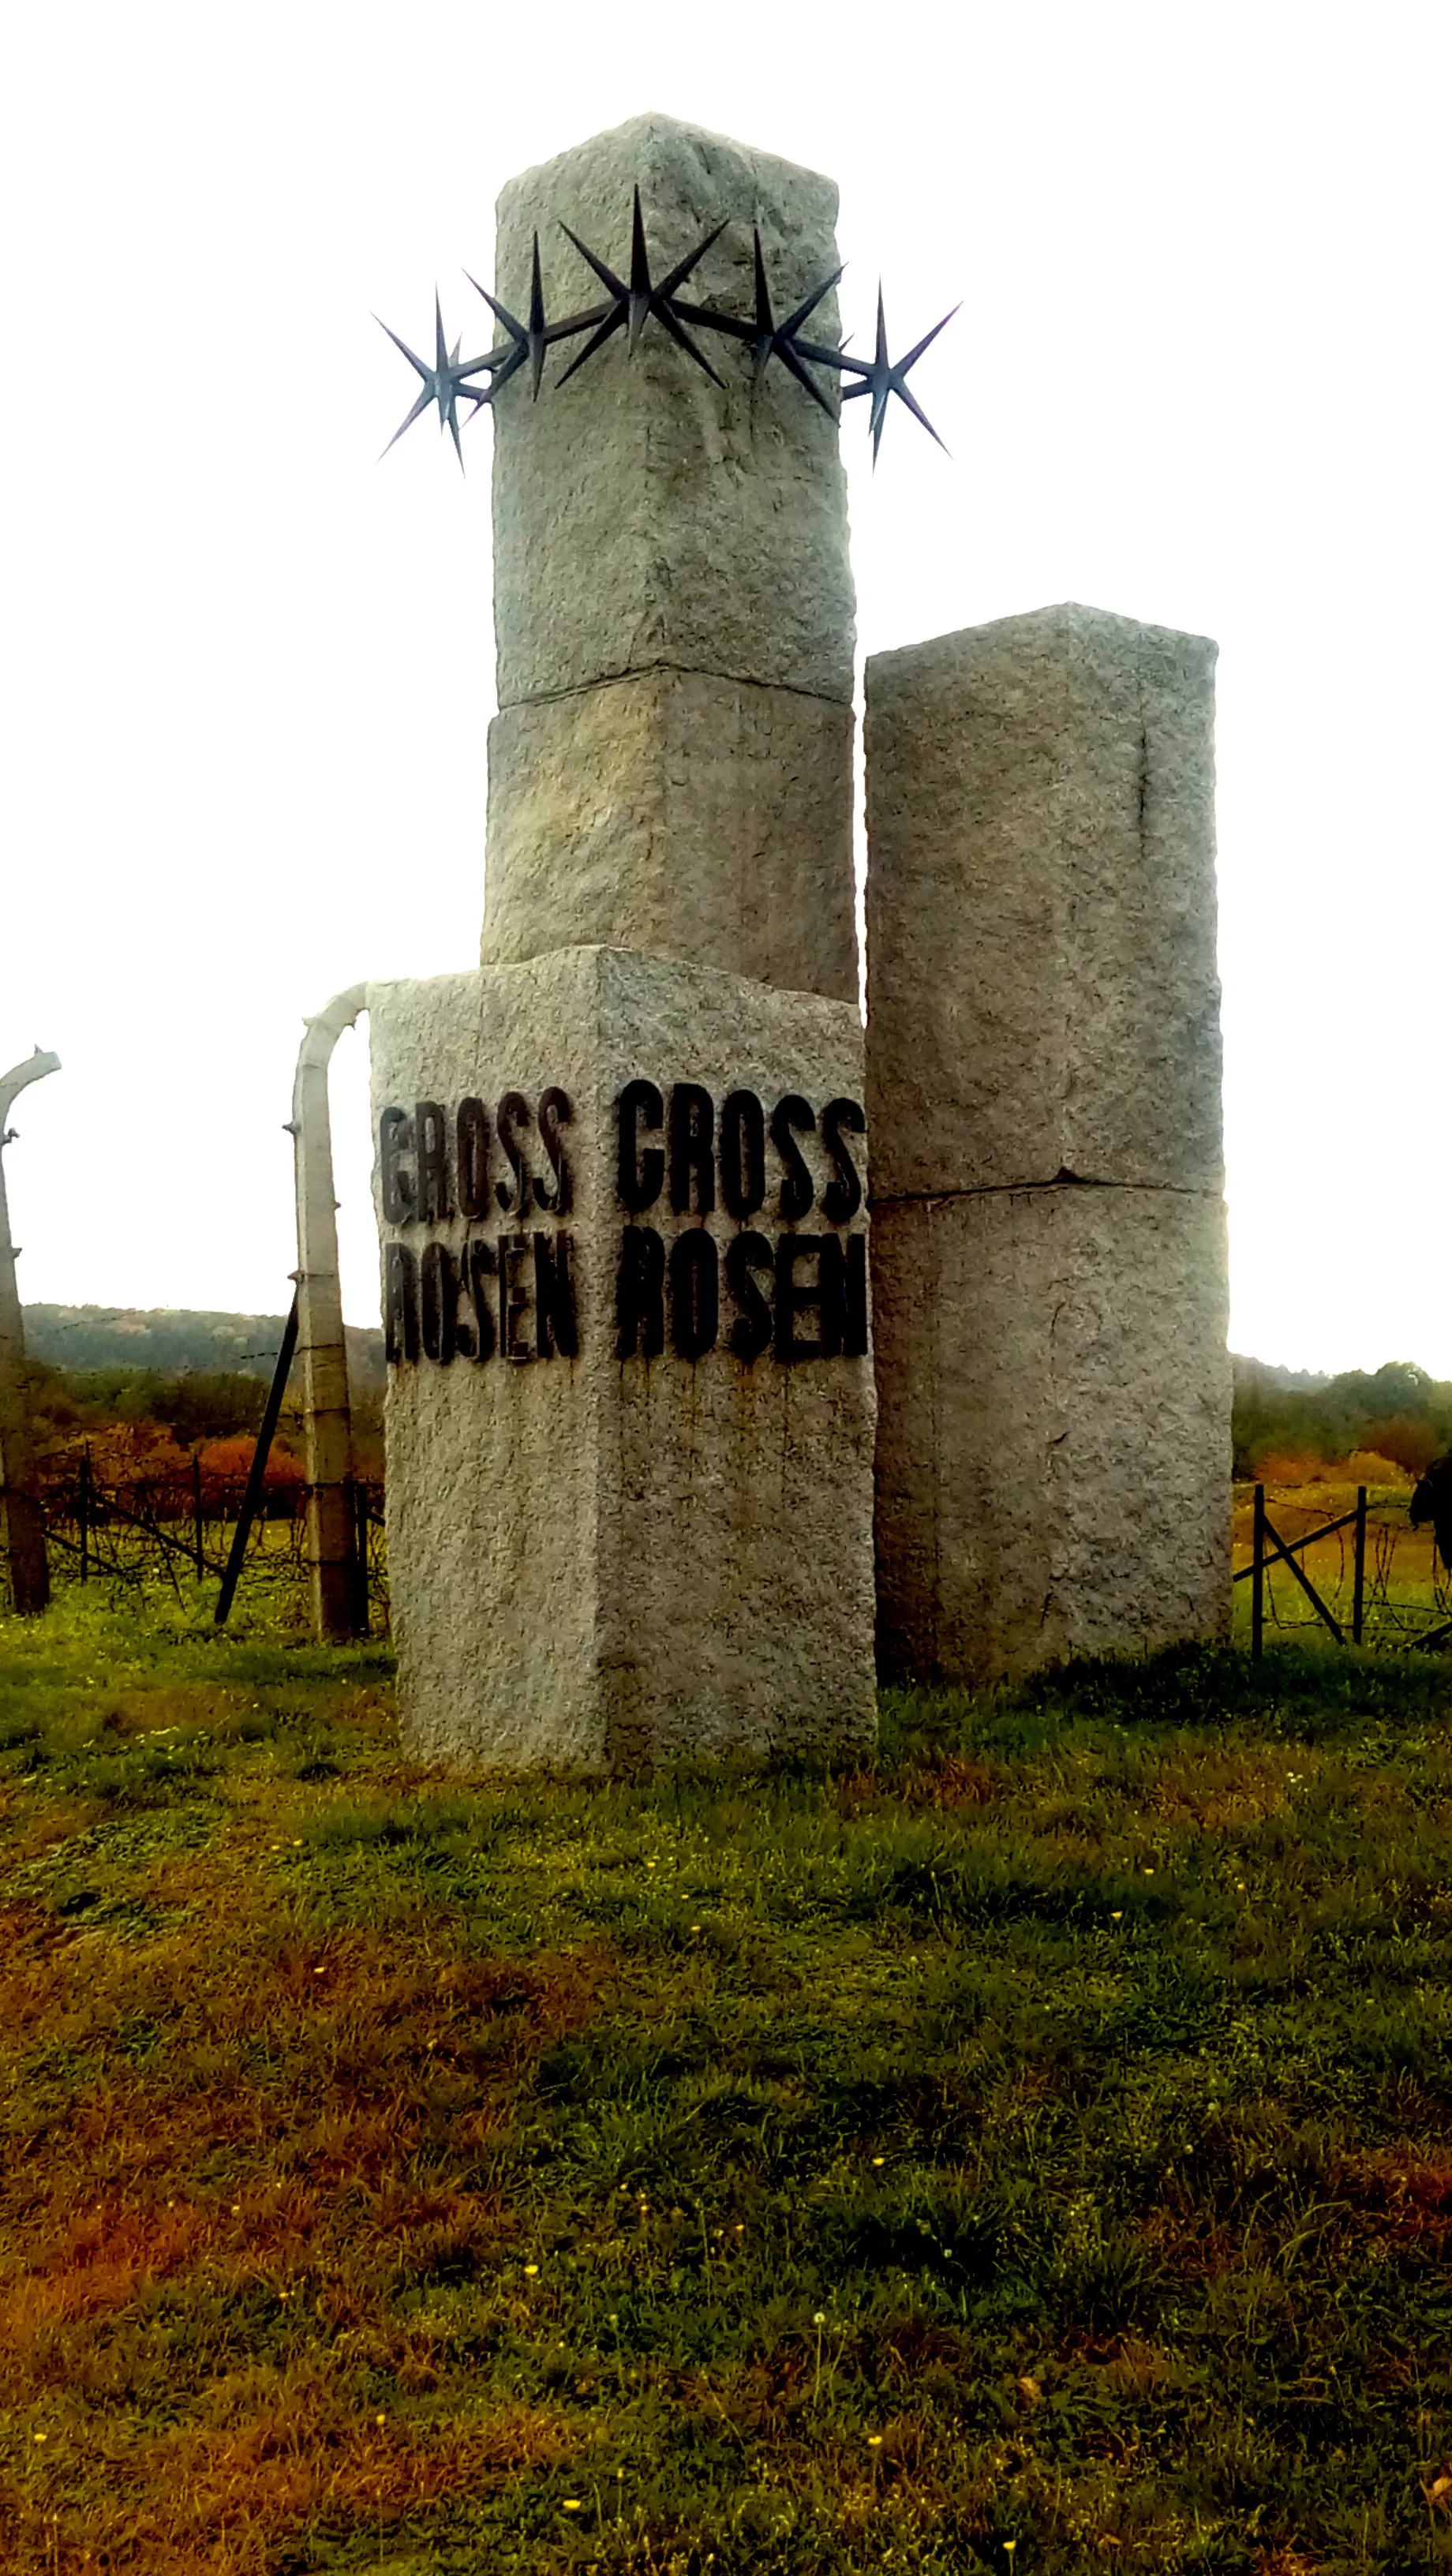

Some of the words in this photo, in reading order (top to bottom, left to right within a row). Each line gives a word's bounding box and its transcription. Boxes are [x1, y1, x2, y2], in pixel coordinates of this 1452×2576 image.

[380, 1087, 574, 1225] GROSS
[617, 1079, 866, 1223] GROSS
[385, 1229, 579, 1365] ROSEN
[616, 1226, 868, 1362] ROSEN
